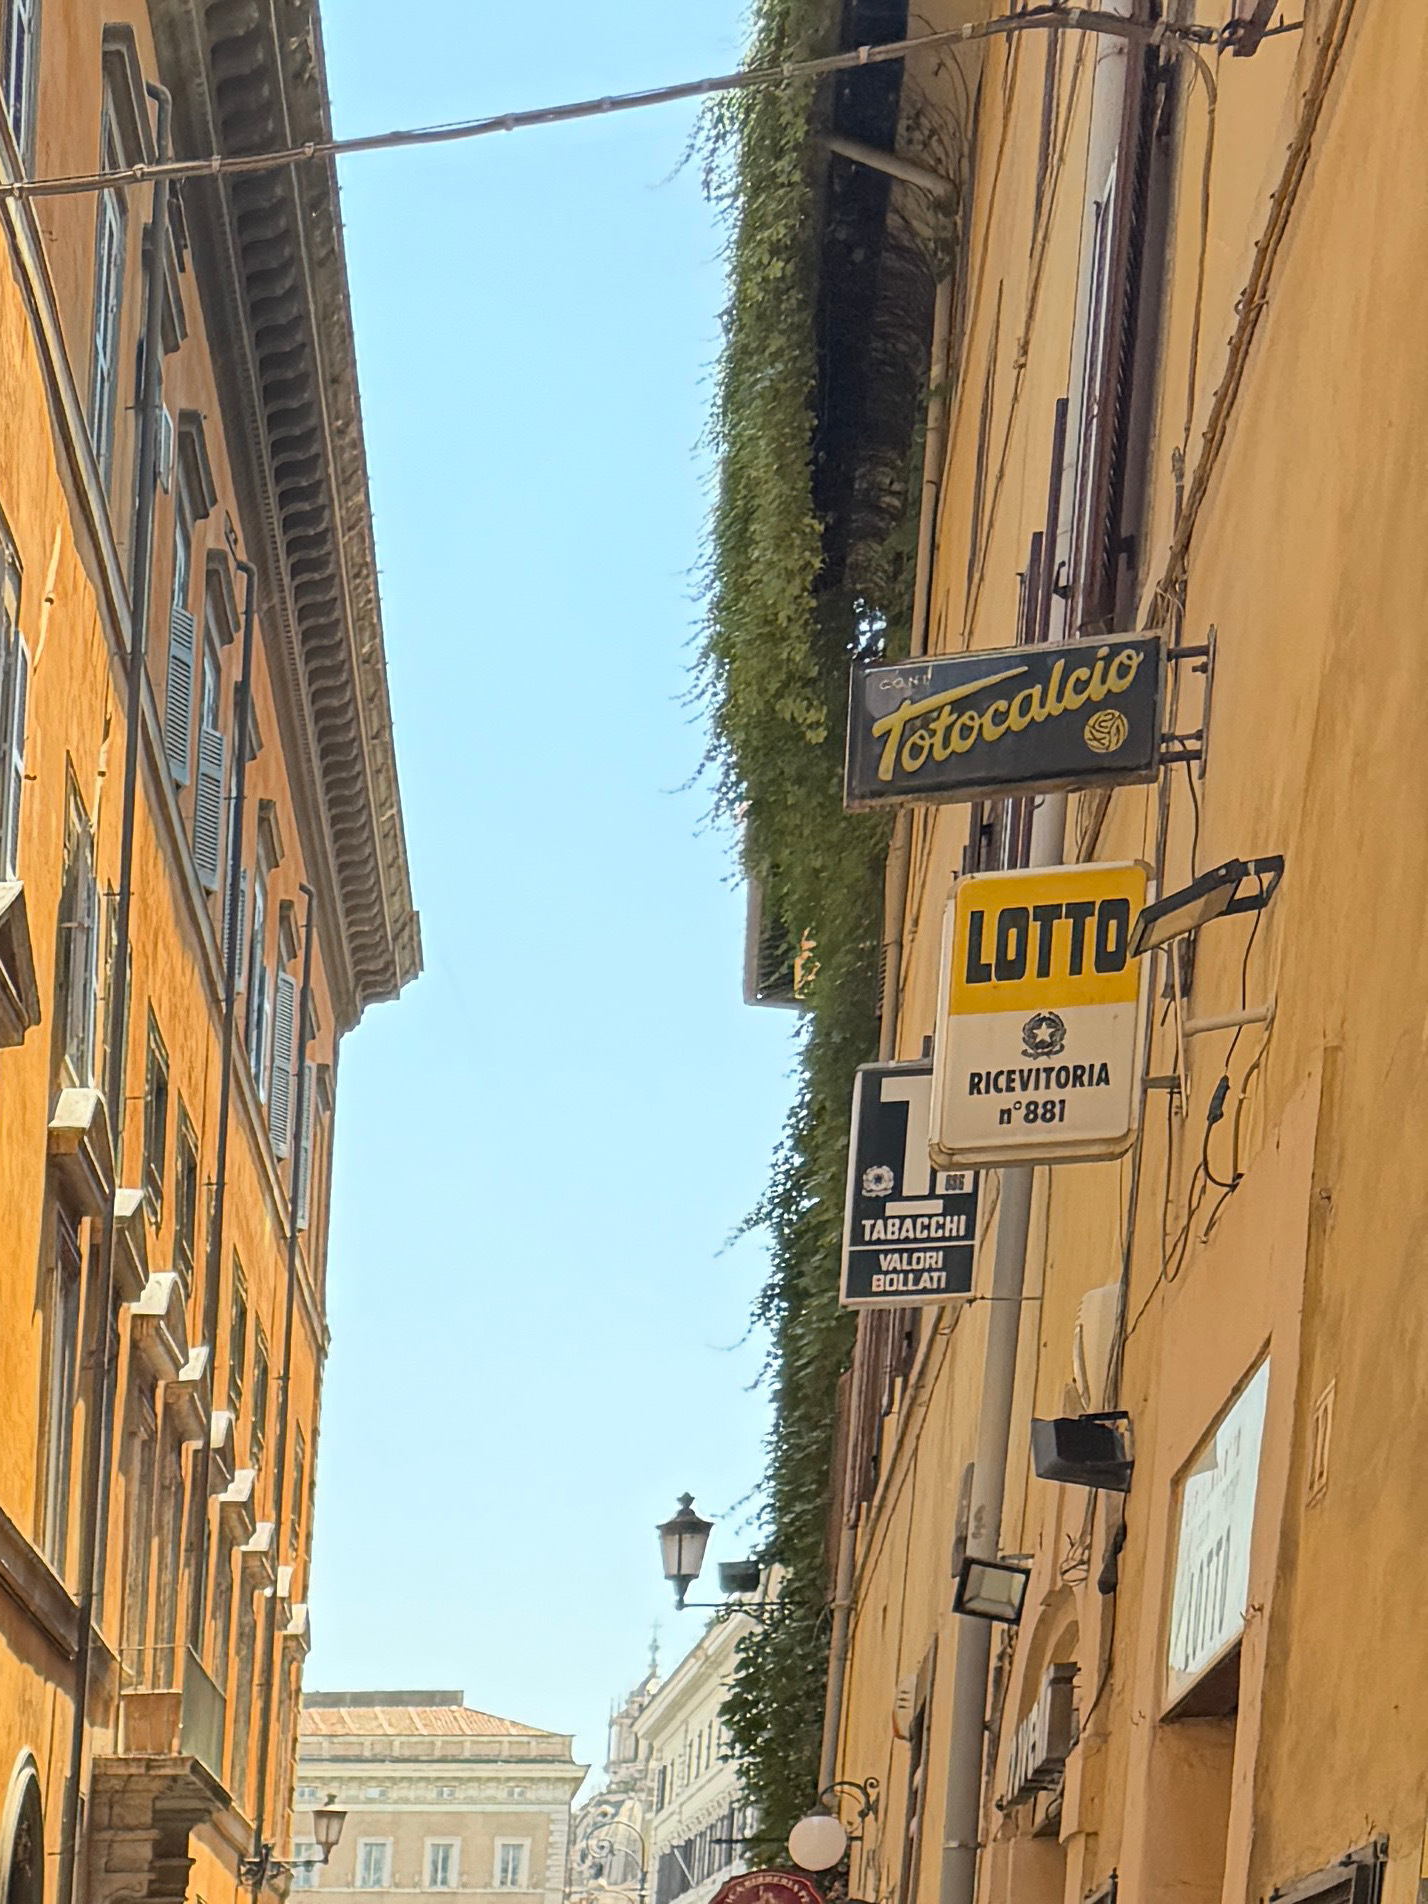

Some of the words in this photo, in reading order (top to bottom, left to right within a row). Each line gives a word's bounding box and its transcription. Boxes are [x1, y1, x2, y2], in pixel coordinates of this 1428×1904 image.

[872, 646, 1144, 782] Totocalcio
[965, 897, 1130, 984] LOTTO
[968, 1062, 1111, 1096] RICEVITORIA
[998, 1099, 1066, 1126] n°881
[861, 1215, 967, 1242] TABACCHI
[879, 1251, 943, 1271] VALORI
[871, 1271, 947, 1292] BOLLATI
